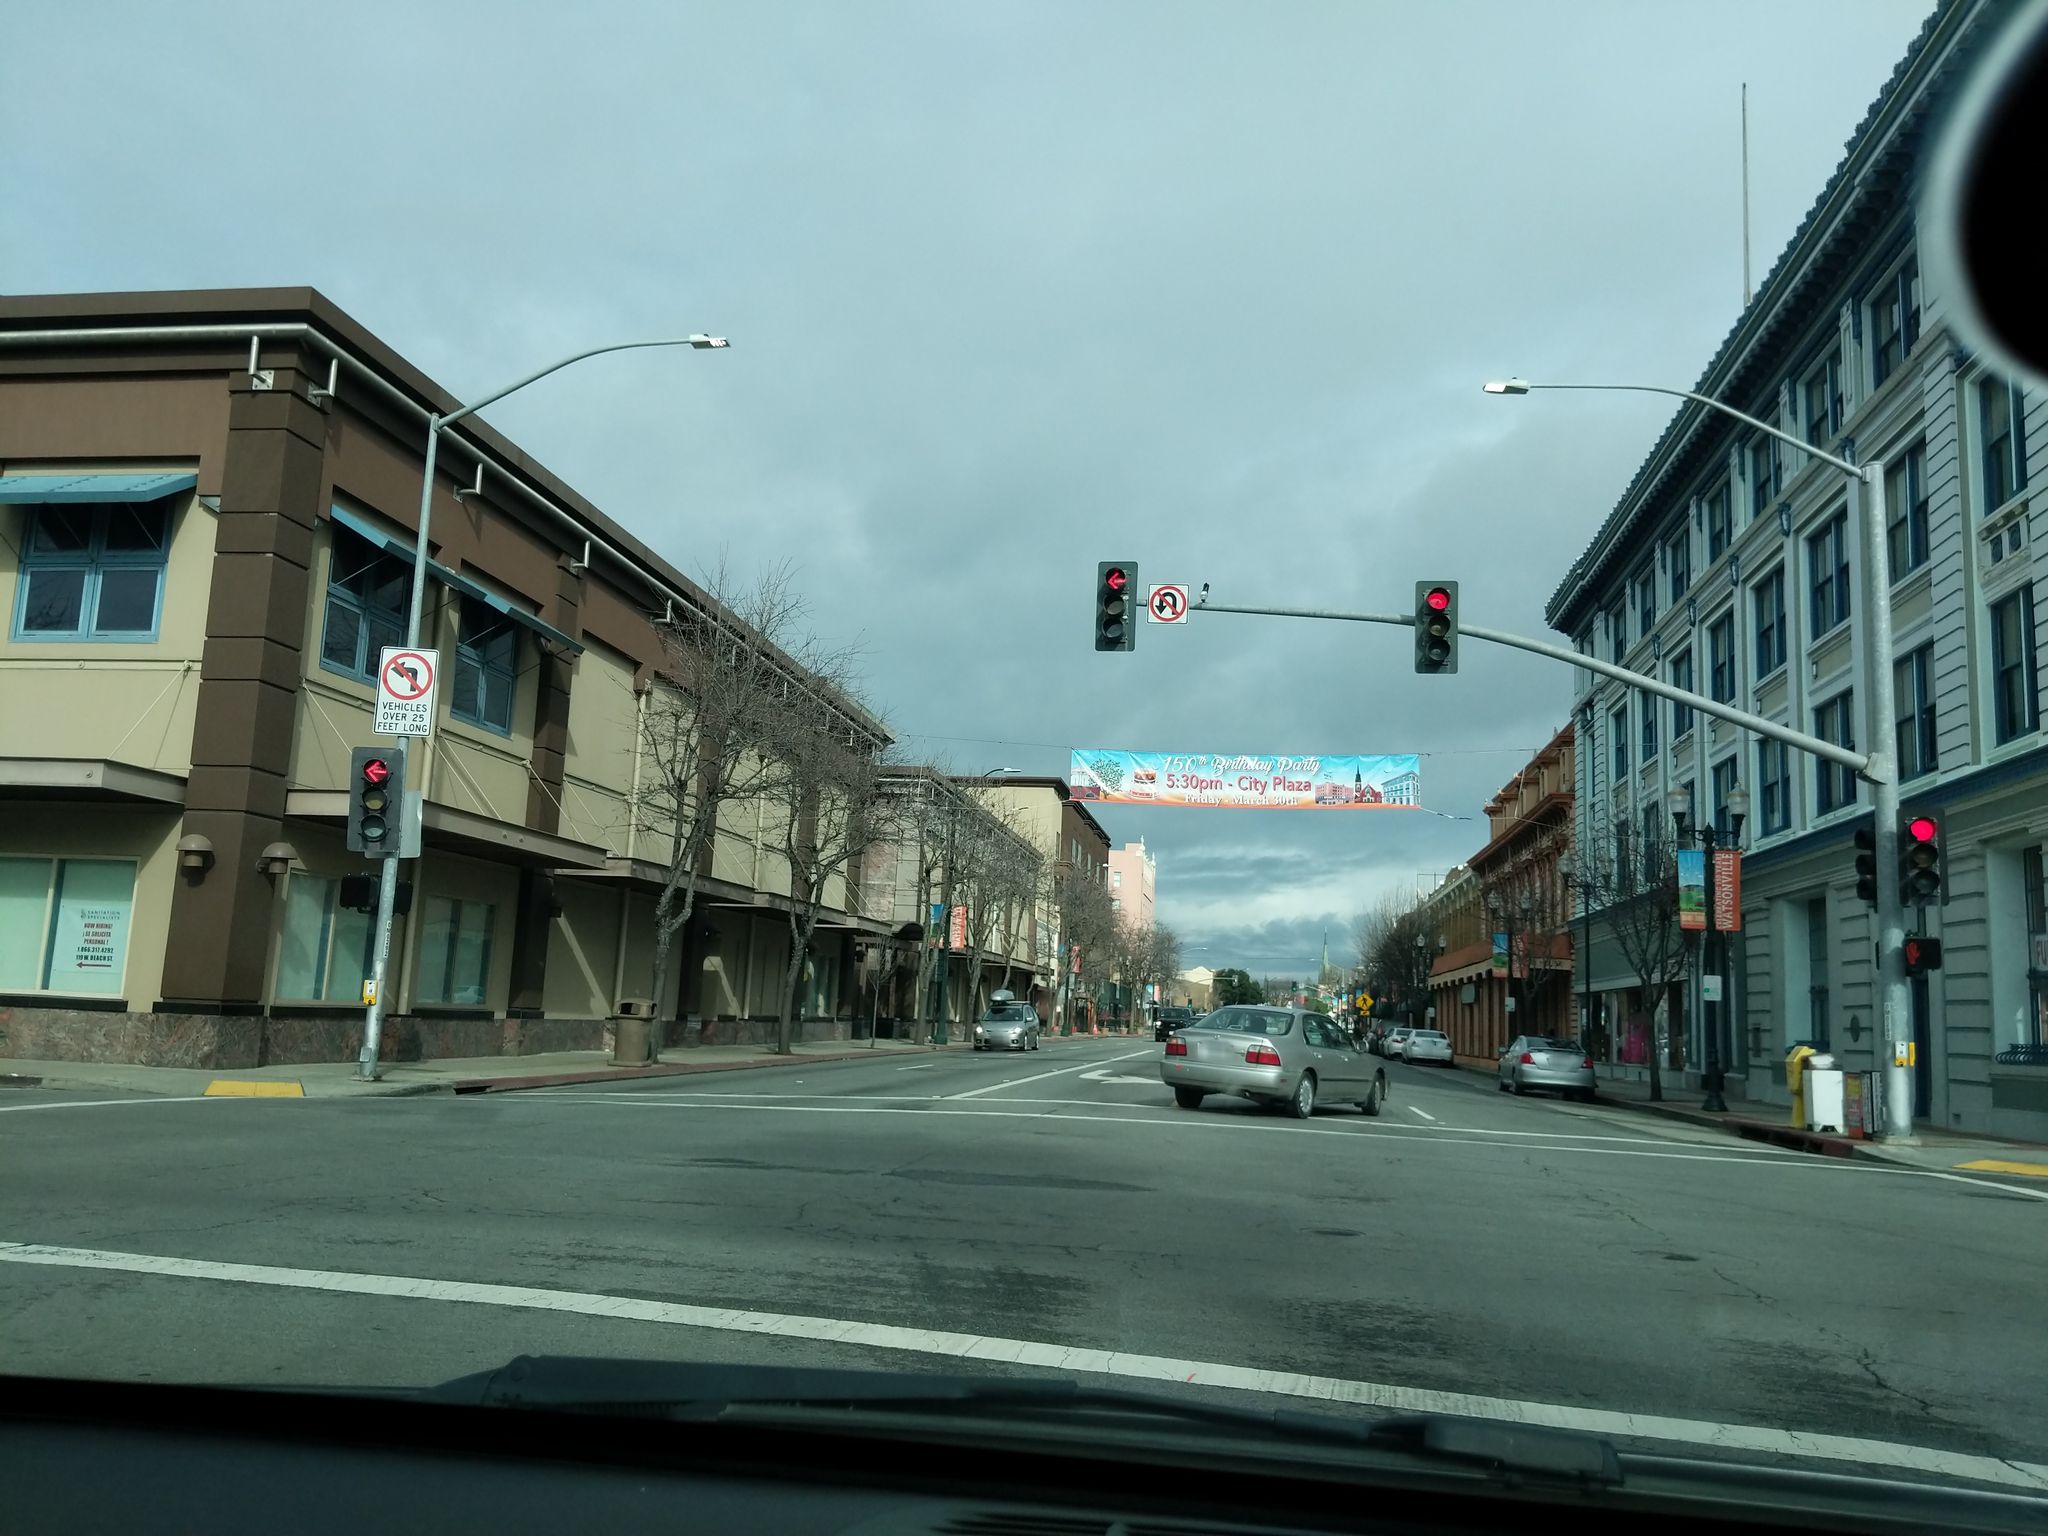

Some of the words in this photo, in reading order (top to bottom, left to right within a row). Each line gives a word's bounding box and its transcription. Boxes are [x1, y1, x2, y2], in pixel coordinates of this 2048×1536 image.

[382, 702, 428, 713] VEHICLES
[382, 712, 407, 721] OVER
[412, 714, 425, 723] 25
[377, 722, 399, 731] FEET
[403, 724, 428, 733] LONG
[1163, 755, 1207, 773] 150th
[1211, 755, 1274, 776] Birthday
[1277, 756, 1321, 776] Party
[1166, 773, 1223, 793] 5:30pm
[1237, 775, 1268, 795] City
[1272, 776, 1312, 791] Plaza
[1184, 794, 1223, 807] Friday
[1232, 795, 1269, 805] March
[1272, 796, 1298, 805] 30th
[1721, 853, 1733, 929] WATSONVILLE
